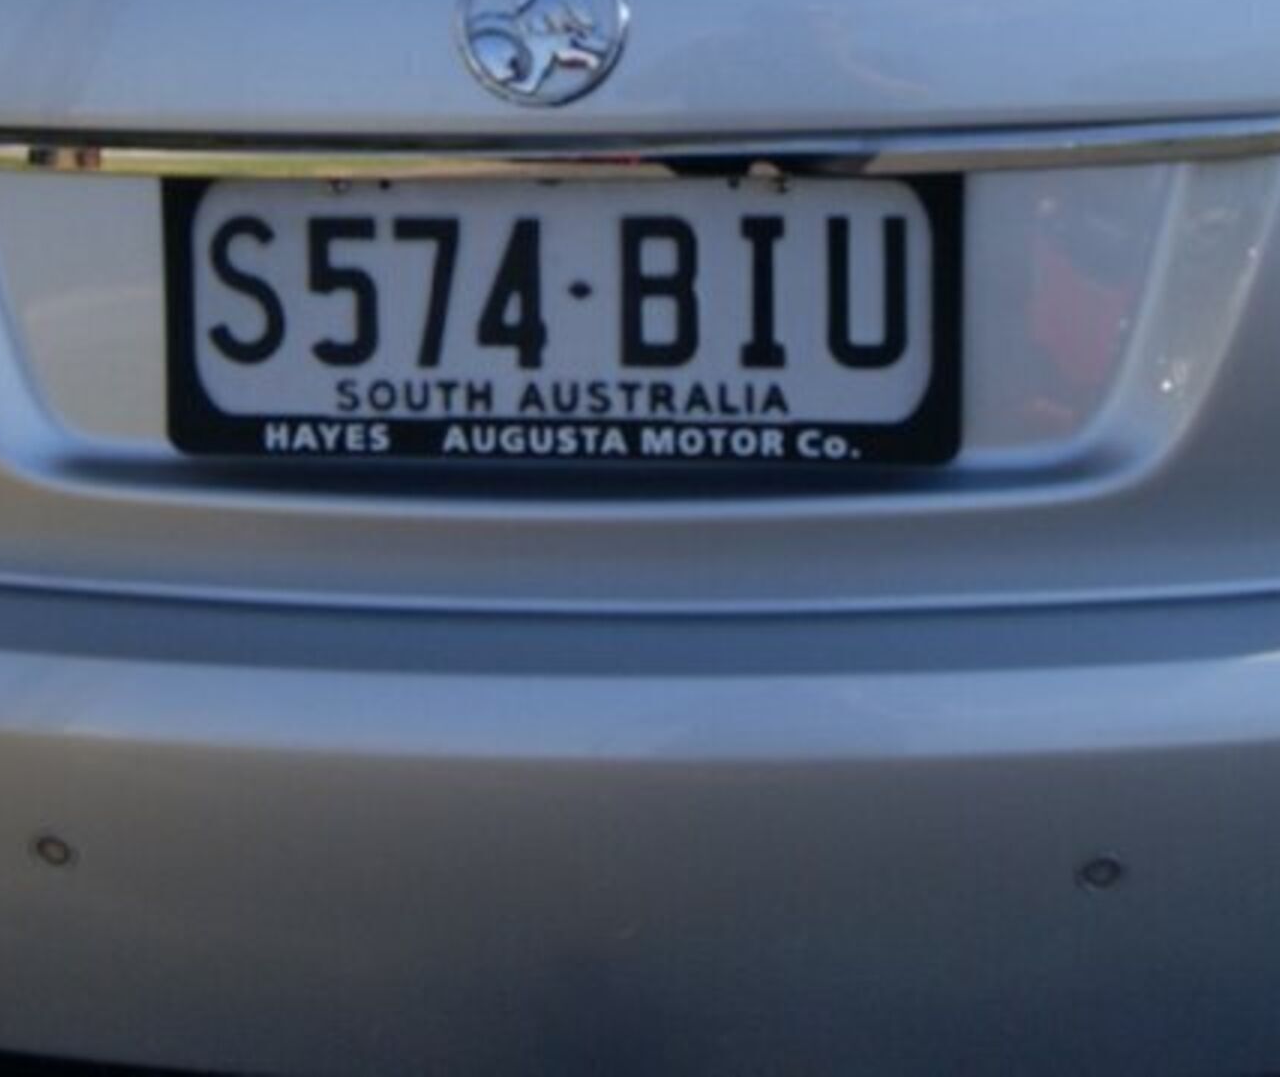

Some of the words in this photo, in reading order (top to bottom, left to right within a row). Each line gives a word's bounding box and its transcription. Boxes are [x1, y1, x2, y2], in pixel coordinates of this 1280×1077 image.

[335, 379, 494, 413] SOUTH
[518, 380, 790, 414] AUSTRALIA
[264, 422, 391, 451] HAYES
[442, 425, 628, 455] AUGUSTA
[640, 427, 785, 458] MOTOR
[796, 428, 862, 460] Co.
